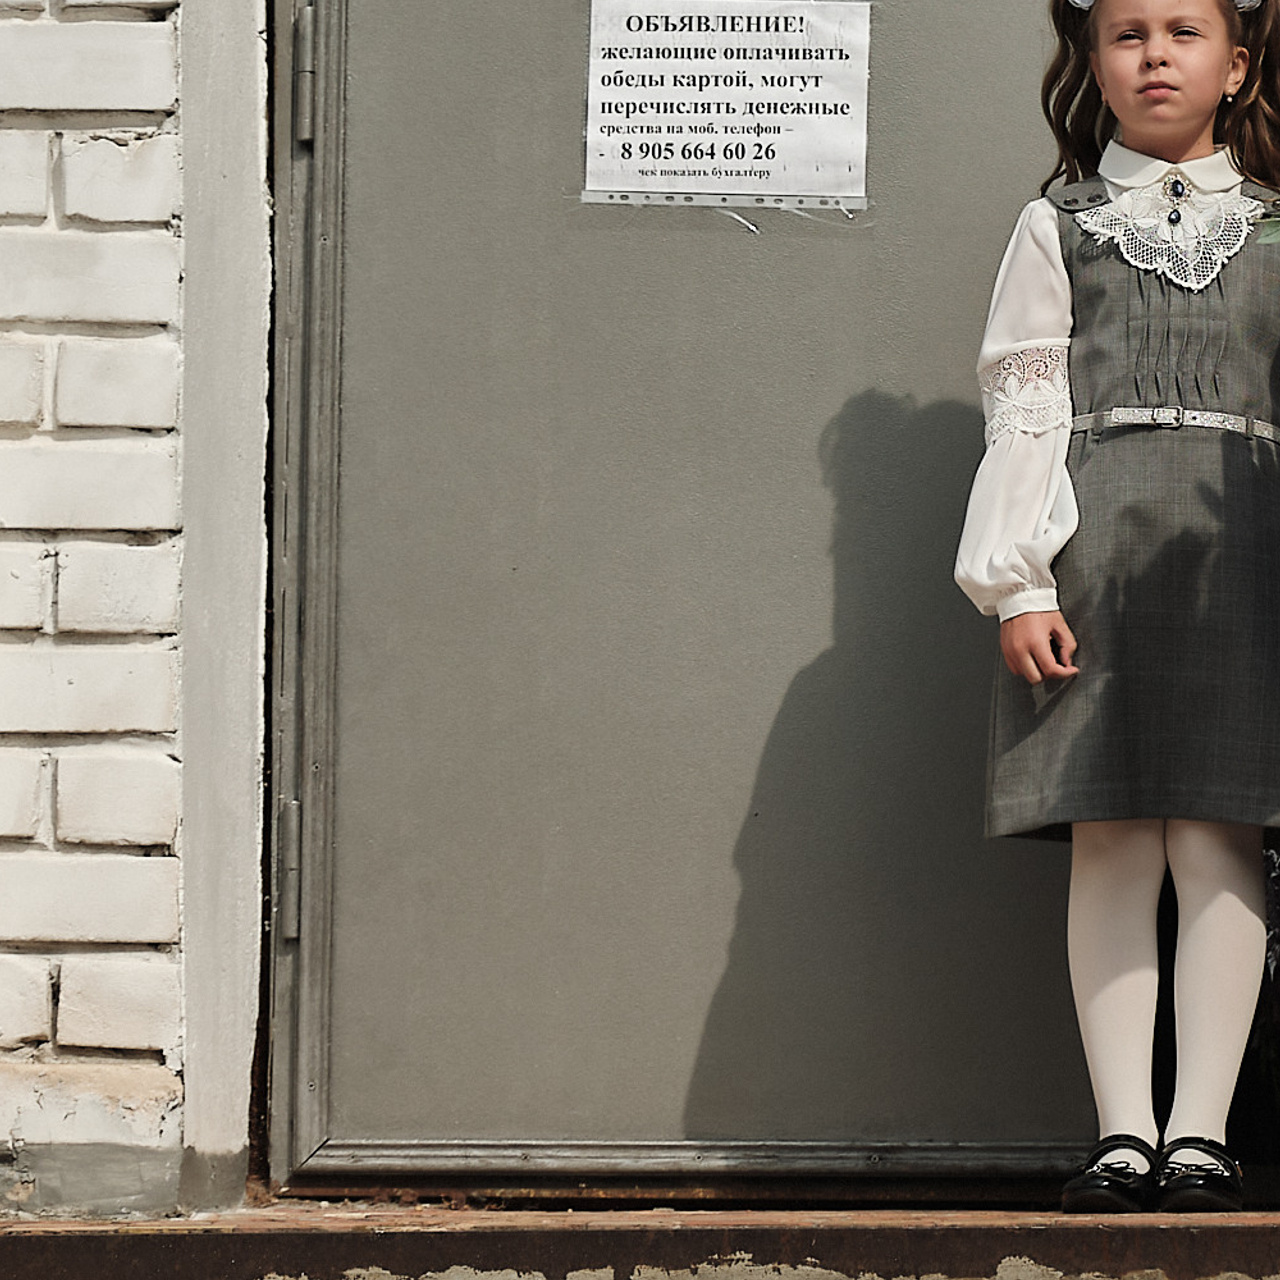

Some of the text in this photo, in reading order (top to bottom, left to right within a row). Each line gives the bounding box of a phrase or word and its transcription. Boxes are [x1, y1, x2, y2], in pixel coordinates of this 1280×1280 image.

[626, 15, 805, 33] ОБЪЯВЛЕНИЕ!
[601, 46, 850, 61] желающие оплачивать
[601, 71, 823, 92] обеды картой, могут
[600, 101, 850, 119] перечислять денежные
[599, 123, 662, 137] средства
[666, 124, 684, 135] на
[687, 123, 718, 135] моб.
[724, 123, 781, 138] телефон
[620, 142, 632, 160] 8
[638, 142, 675, 160] 905
[681, 142, 716, 160] 664
[722, 142, 746, 160] 60
[752, 142, 776, 160] 26
[638, 168, 771, 179] чек показать бухгалтеру
